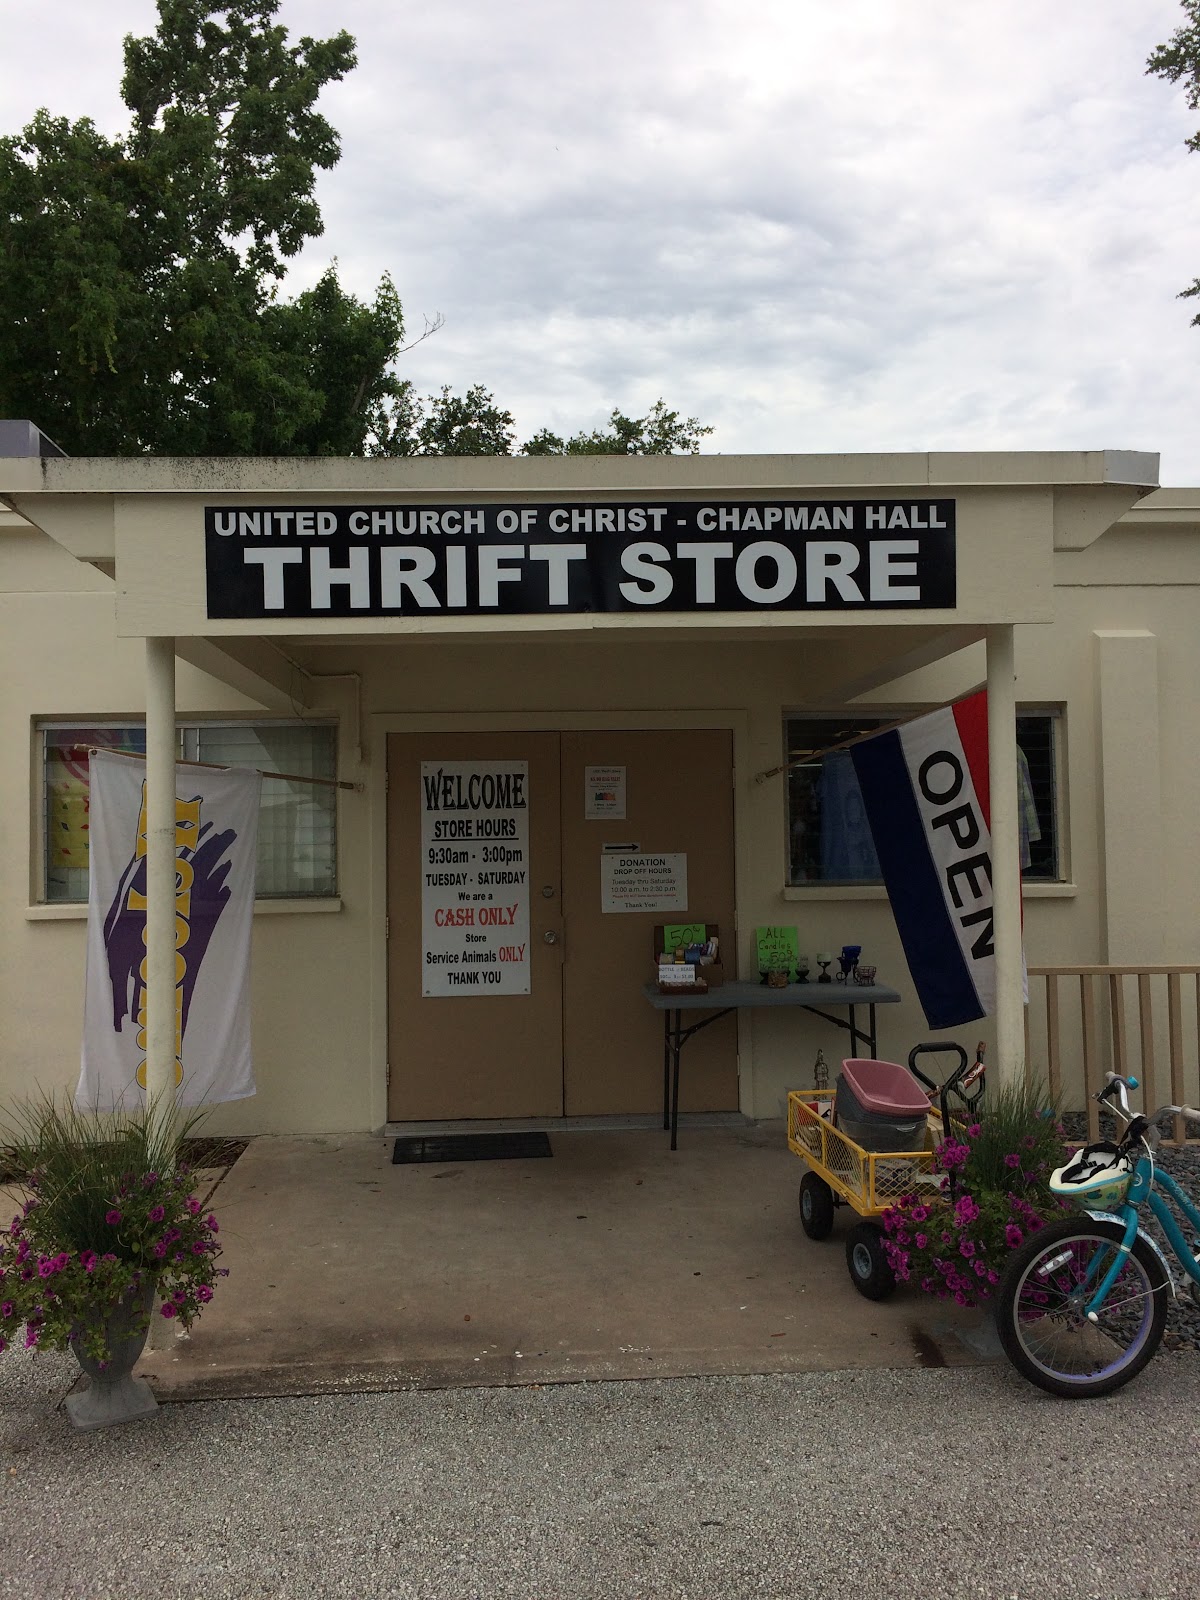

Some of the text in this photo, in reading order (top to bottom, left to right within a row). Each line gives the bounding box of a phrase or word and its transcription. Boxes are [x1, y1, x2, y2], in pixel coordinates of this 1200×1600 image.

[213, 512, 339, 537] UNITED
[348, 510, 489, 536] CHURCH
[496, 510, 538, 534] OF
[548, 509, 668, 534] CHRIST
[696, 507, 855, 531] CHAPMAN
[865, 506, 947, 530] HALL
[244, 539, 921, 610] THRIFT STORE
[424, 768, 526, 810] WELCOME
[435, 819, 516, 838] STORE HOURS
[429, 847, 468, 864] 9:30am
[482, 846, 522, 865] 3:00pm
[918, 750, 994, 960] OPEN
[426, 873, 467, 886] TUESDAY
[478, 872, 525, 885] SATURDAY
[458, 892, 470, 900] We
[435, 904, 518, 926] CASH ONLY
[465, 934, 486, 942] Store
[766, 928, 785, 938] ALL
[427, 944, 525, 964] Service Animals ONLY
[759, 940, 790, 949] Candles
[448, 972, 501, 985] THANK YOU
